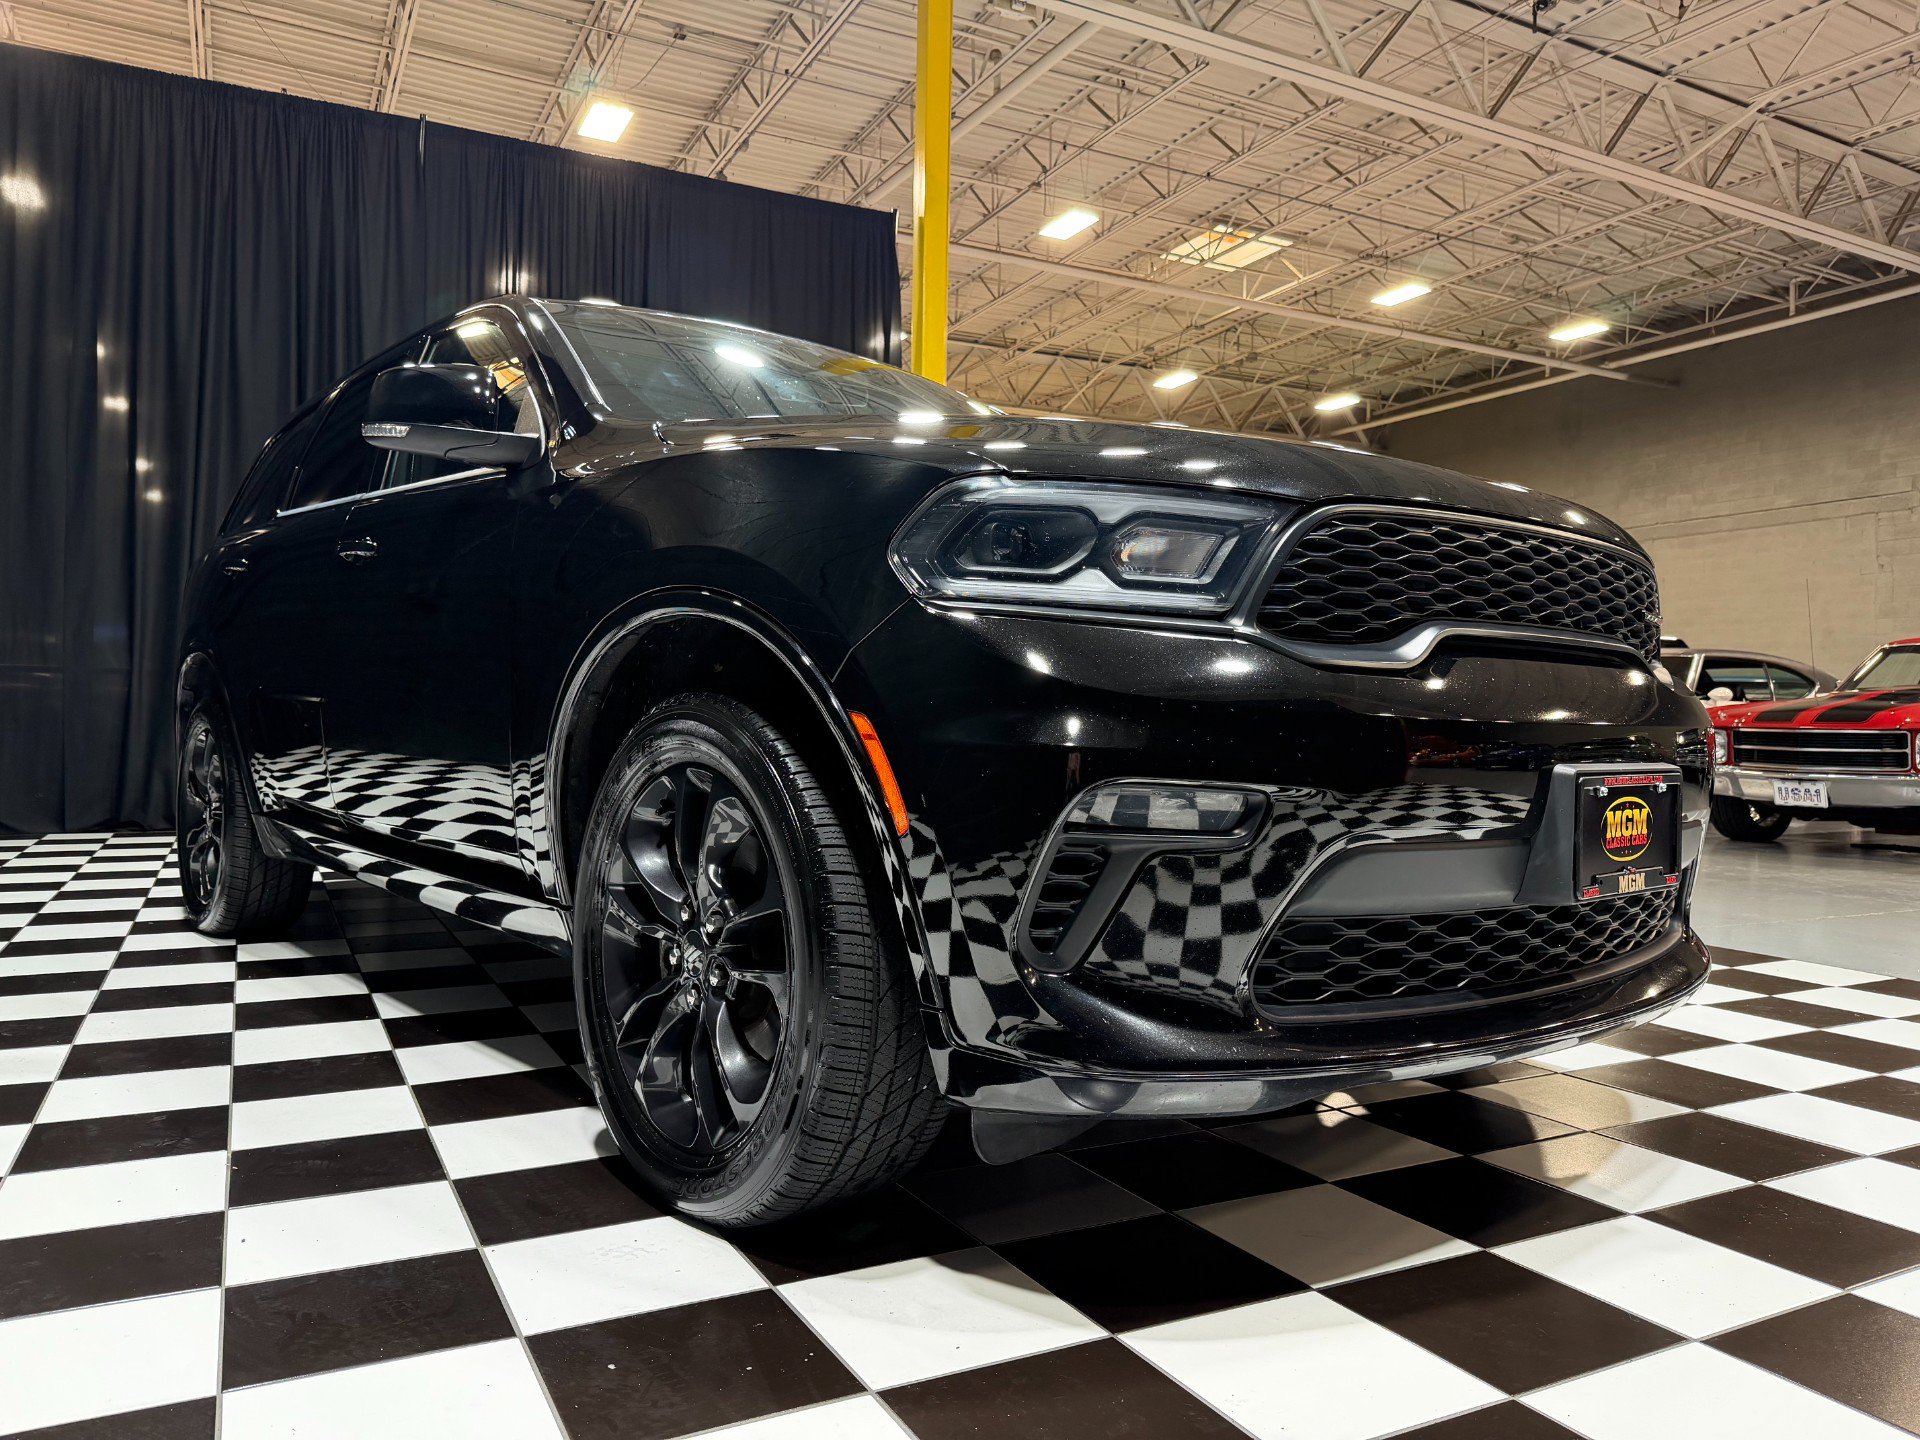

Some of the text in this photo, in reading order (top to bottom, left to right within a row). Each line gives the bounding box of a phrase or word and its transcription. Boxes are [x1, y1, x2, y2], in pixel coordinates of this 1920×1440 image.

[1606, 808, 1649, 838] MGM
[1606, 834, 1648, 849] CLASSIC CARS
[1618, 873, 1645, 893] MGM
